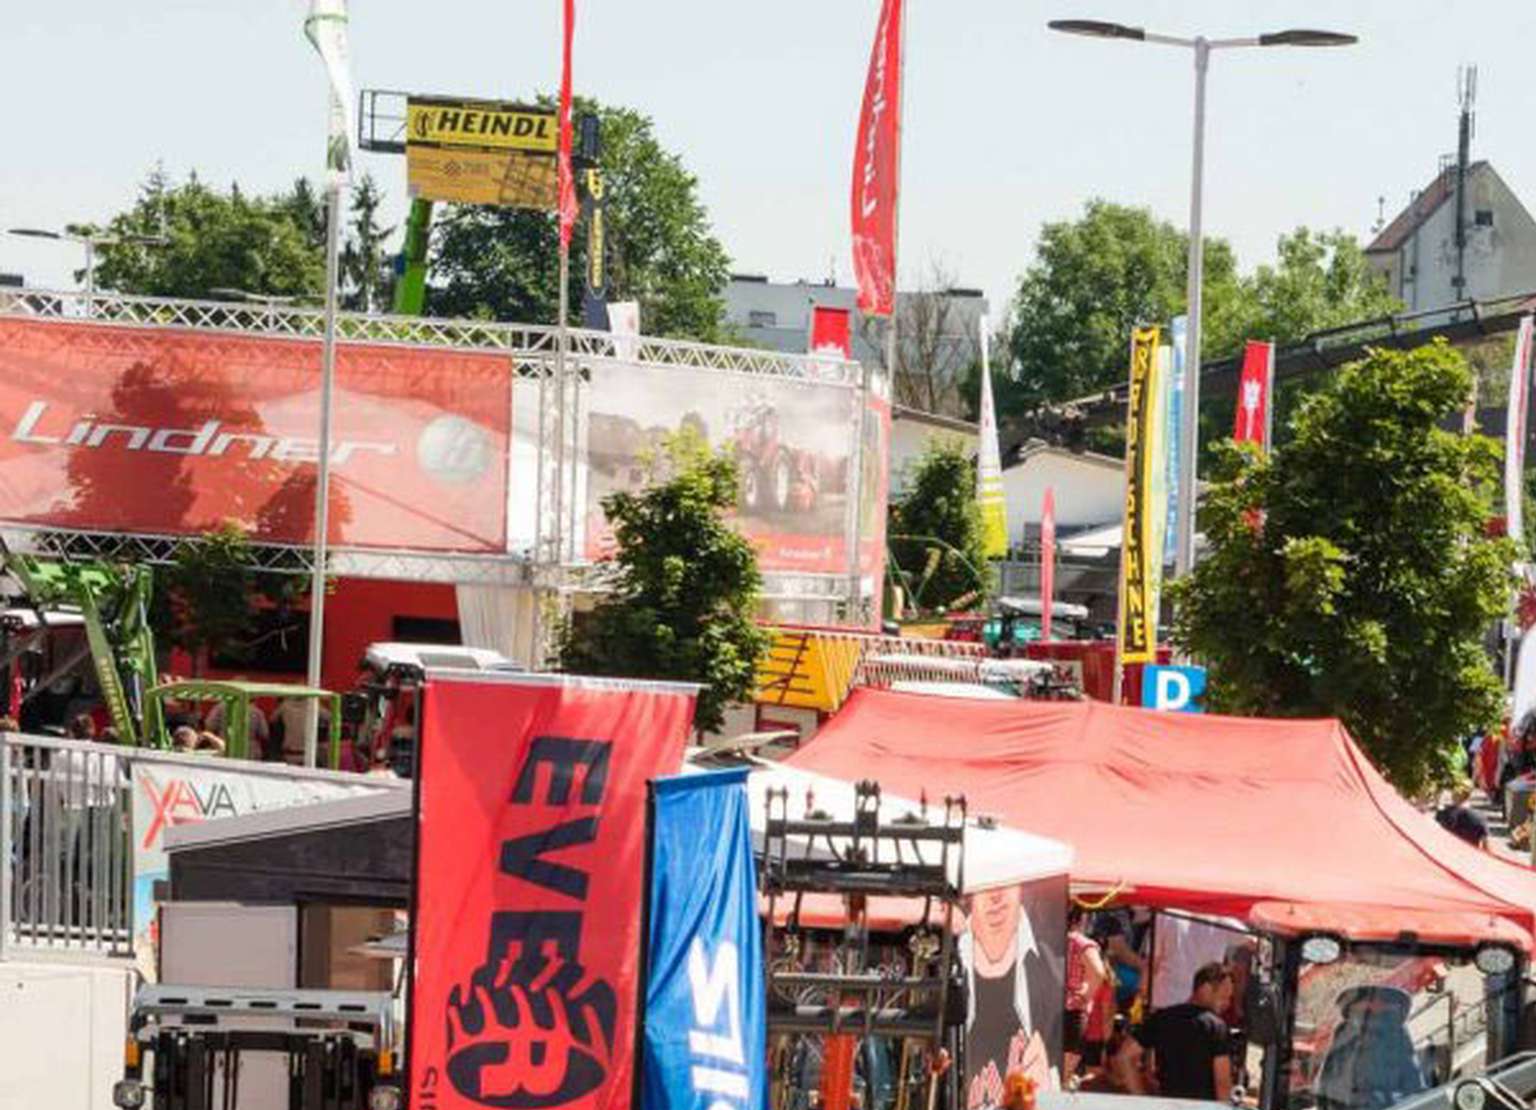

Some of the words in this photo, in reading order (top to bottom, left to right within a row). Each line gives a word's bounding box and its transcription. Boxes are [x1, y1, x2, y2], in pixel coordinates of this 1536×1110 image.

[437, 111, 549, 139] HEINDL
[11, 402, 397, 466] Lindner
[137, 773, 239, 850] XAVA
